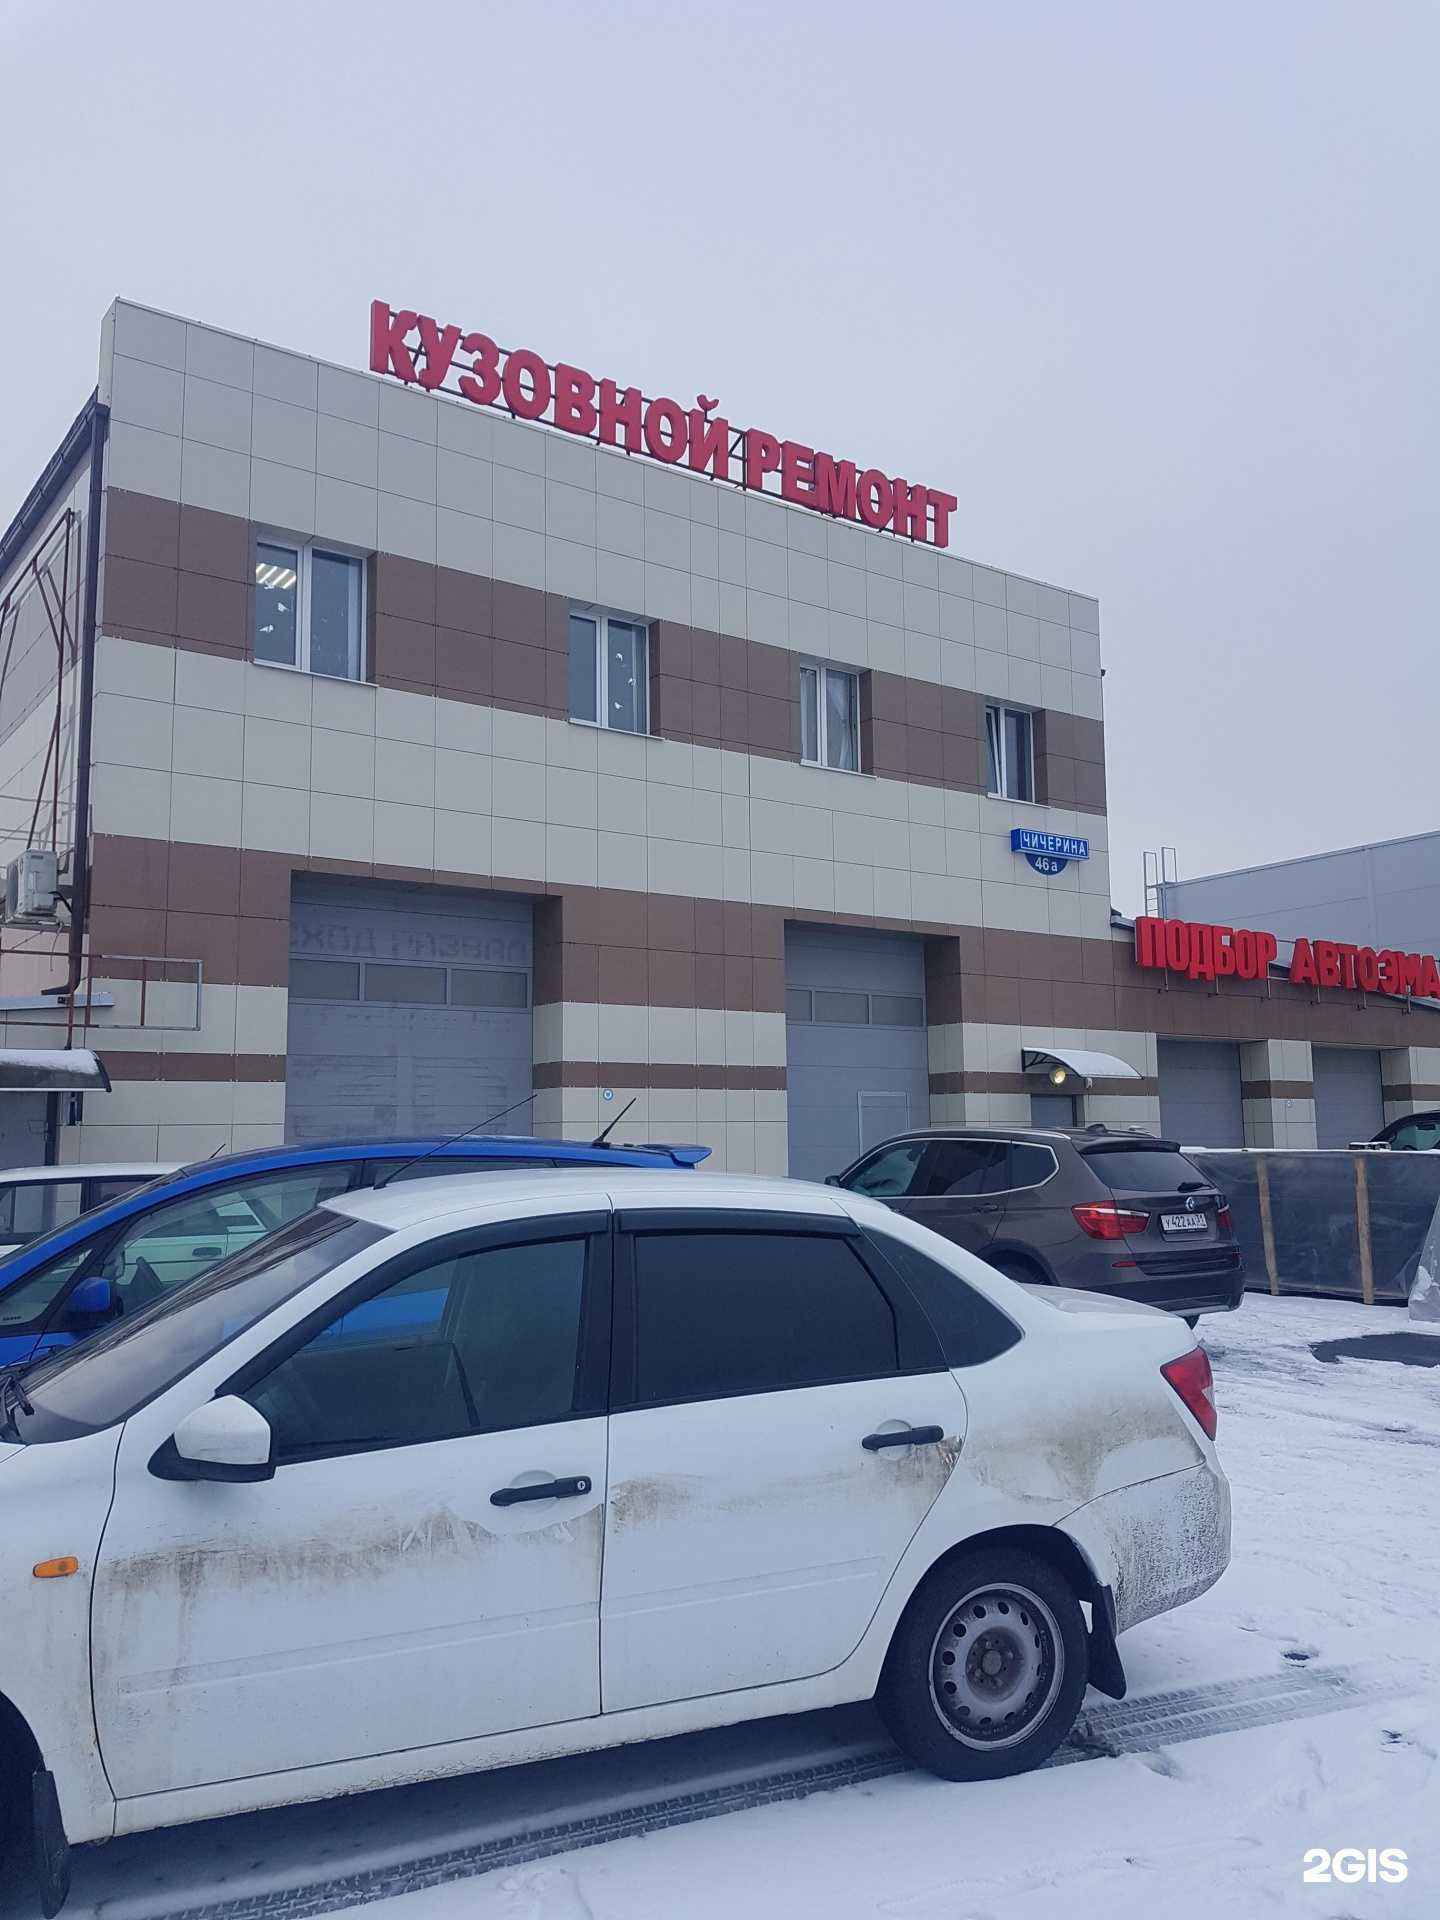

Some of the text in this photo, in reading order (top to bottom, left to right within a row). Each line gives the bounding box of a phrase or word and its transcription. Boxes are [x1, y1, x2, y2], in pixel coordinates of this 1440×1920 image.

[370, 299, 957, 548] КУЗОВНОЙ РЕМОНТ
[1023, 832, 1087, 856] ЧИЧЕРИНА
[1135, 916, 1277, 982] ПОДБОР
